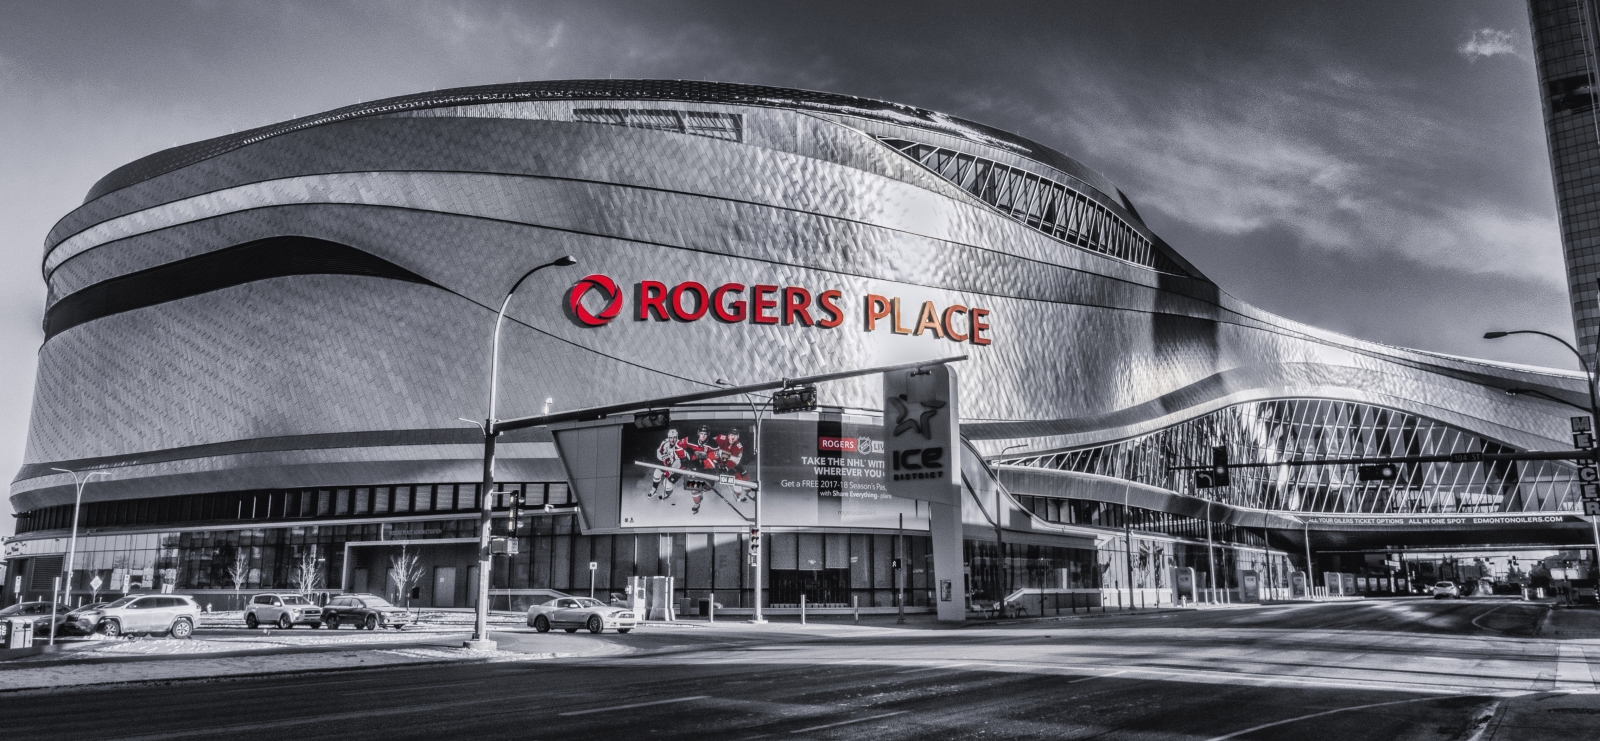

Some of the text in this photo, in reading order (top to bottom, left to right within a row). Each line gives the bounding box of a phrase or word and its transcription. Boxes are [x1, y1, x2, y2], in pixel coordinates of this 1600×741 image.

[636, 279, 992, 346] ROGERS PLACE
[822, 440, 855, 449] ROGERS
[801, 456, 826, 465] TAKE
[827, 457, 845, 466] THE
[868, 460, 885, 468] WIT
[813, 467, 863, 476] WHEREVER
[864, 469, 881, 478] YOU
[893, 471, 943, 481] DISTRICT
[781, 480, 795, 488] Get
[802, 480, 819, 488] FREE
[820, 481, 849, 489] 2017-18
[849, 482, 876, 490] Season's
[1473, 516, 1563, 524] EDMONTONOILERS.COM
